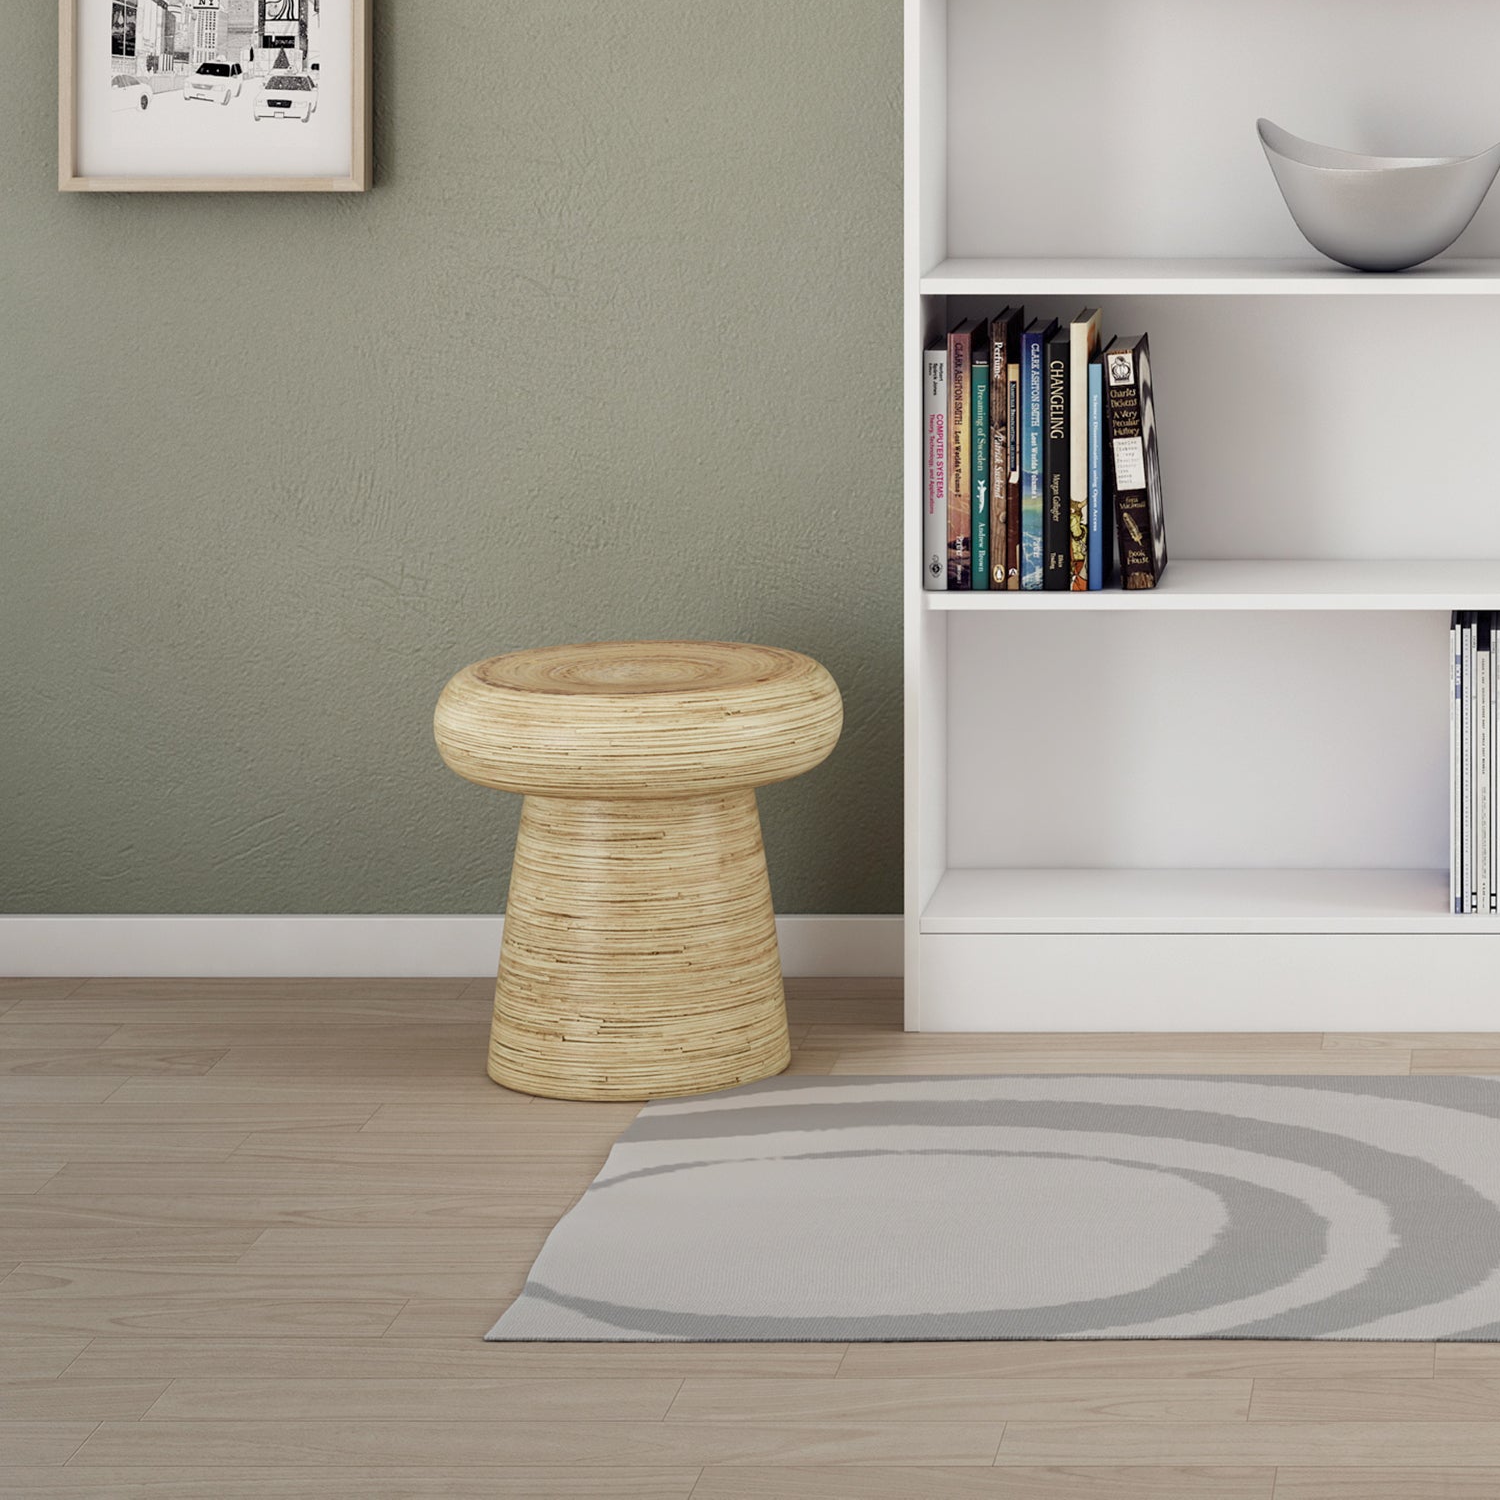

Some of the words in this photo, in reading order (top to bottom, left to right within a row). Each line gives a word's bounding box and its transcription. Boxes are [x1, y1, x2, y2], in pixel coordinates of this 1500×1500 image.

[954, 342, 963, 370] CLARK
[994, 342, 1003, 379] Perfume
[1031, 343, 1040, 369] CLARK
[954, 370, 963, 400] ASHTON
[1031, 370, 1040, 401] ASHTON
[1110, 389, 1136, 398] Charles
[976, 385, 986, 426] Dreaming
[1050, 360, 1064, 438] CHANGELING
[1111, 399, 1137, 408] Dickens
[954, 402, 963, 425] SMITH
[1031, 403, 1040, 427] SMITH
[1120, 410, 1137, 419] Very
[976, 428, 986, 436] of
[1114, 428, 1140, 437] History
[976, 438, 986, 471] Sweden
[1050, 474, 1060, 495] Morgan
[1050, 496, 1060, 522] Gallagher
[978, 522, 986, 548] Andrew
[978, 550, 986, 572] Brown
